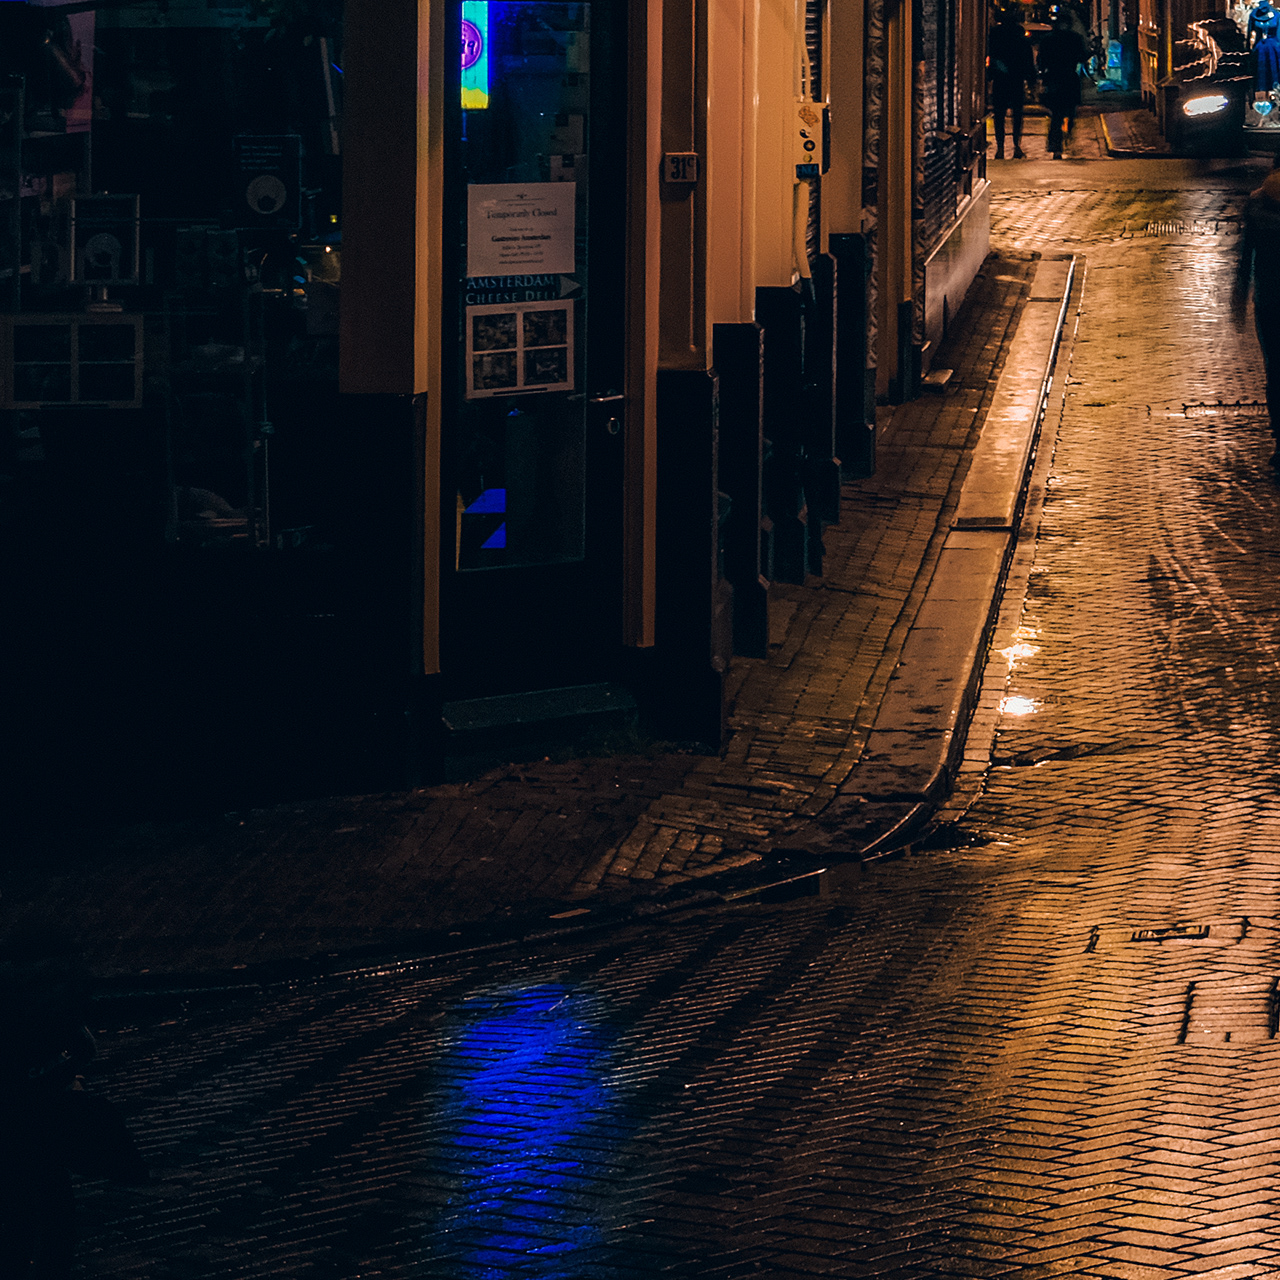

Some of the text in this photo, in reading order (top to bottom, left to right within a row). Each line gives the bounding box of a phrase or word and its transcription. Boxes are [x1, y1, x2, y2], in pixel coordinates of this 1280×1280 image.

[532, 207, 558, 218] Closed
[466, 275, 555, 290] AMSTERDAM
[465, 291, 518, 304] CHEESE
